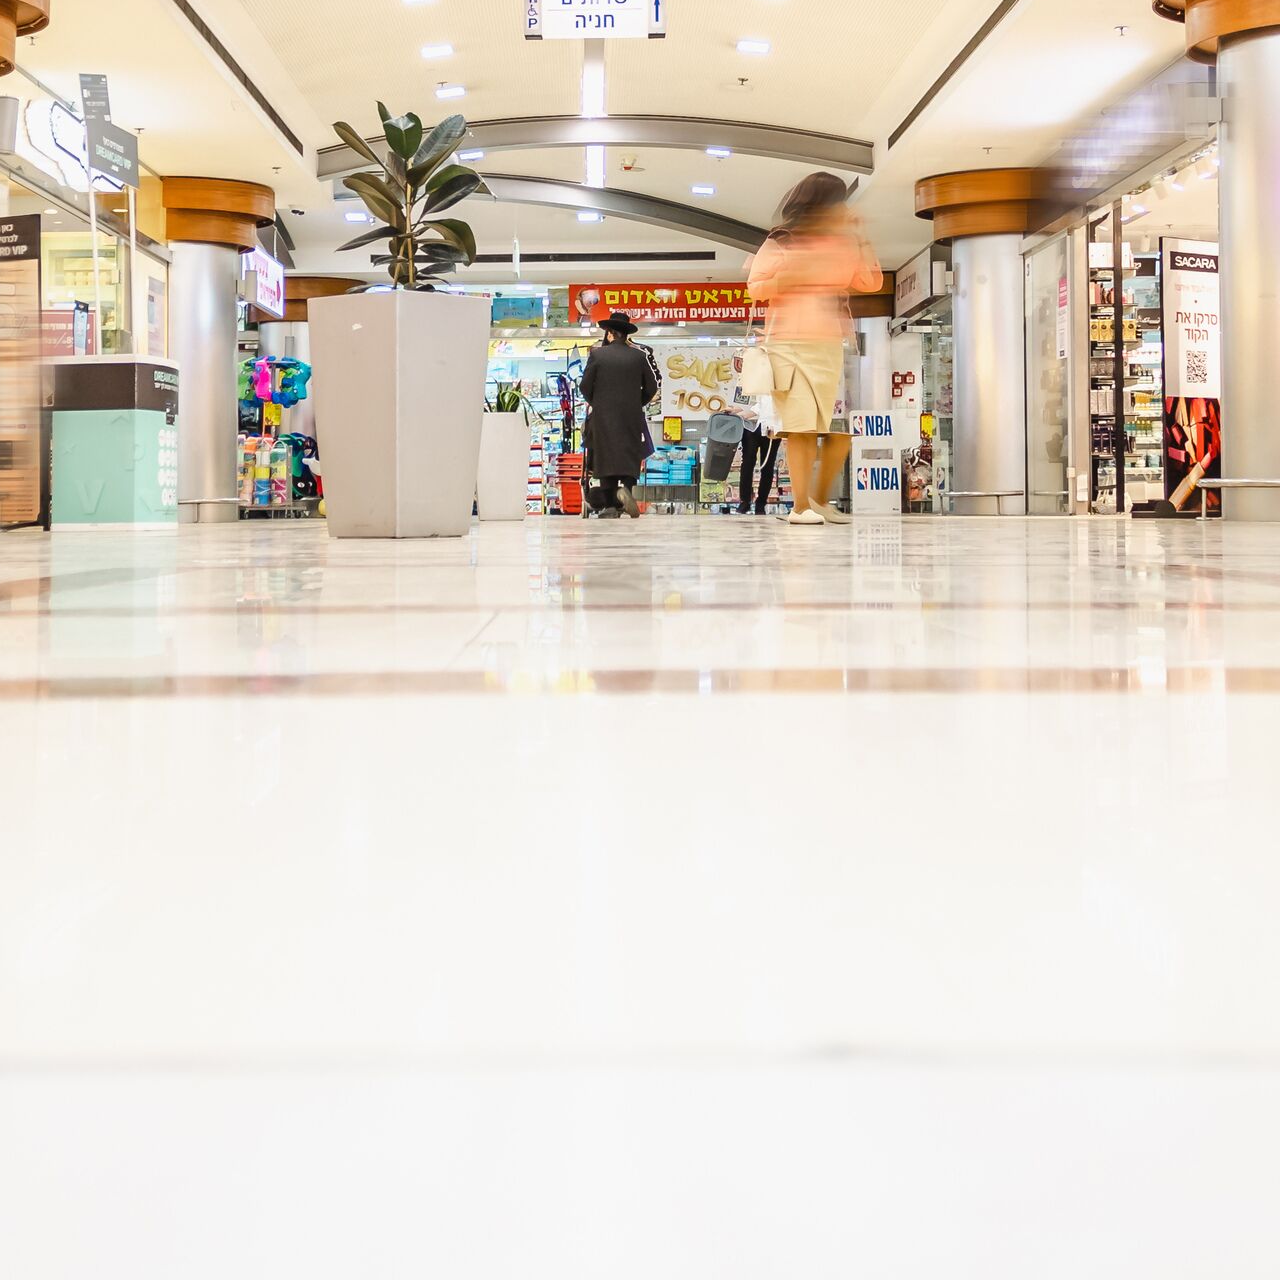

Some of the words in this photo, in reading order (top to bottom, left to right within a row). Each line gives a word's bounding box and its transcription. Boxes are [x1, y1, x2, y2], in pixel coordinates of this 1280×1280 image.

[576, 14, 615, 28] חניה
[12, 245, 28, 256] VIP
[1174, 256, 1216, 269] SACARA
[654, 308, 687, 319] הזולה
[690, 308, 745, 319] הצעצועים
[1175, 312, 1191, 324] את
[1194, 313, 1217, 327] סרקו
[1185, 328, 1209, 343] הקוד
[666, 354, 733, 389] SALE
[865, 415, 892, 436] NBA
[870, 467, 899, 490] NBA
